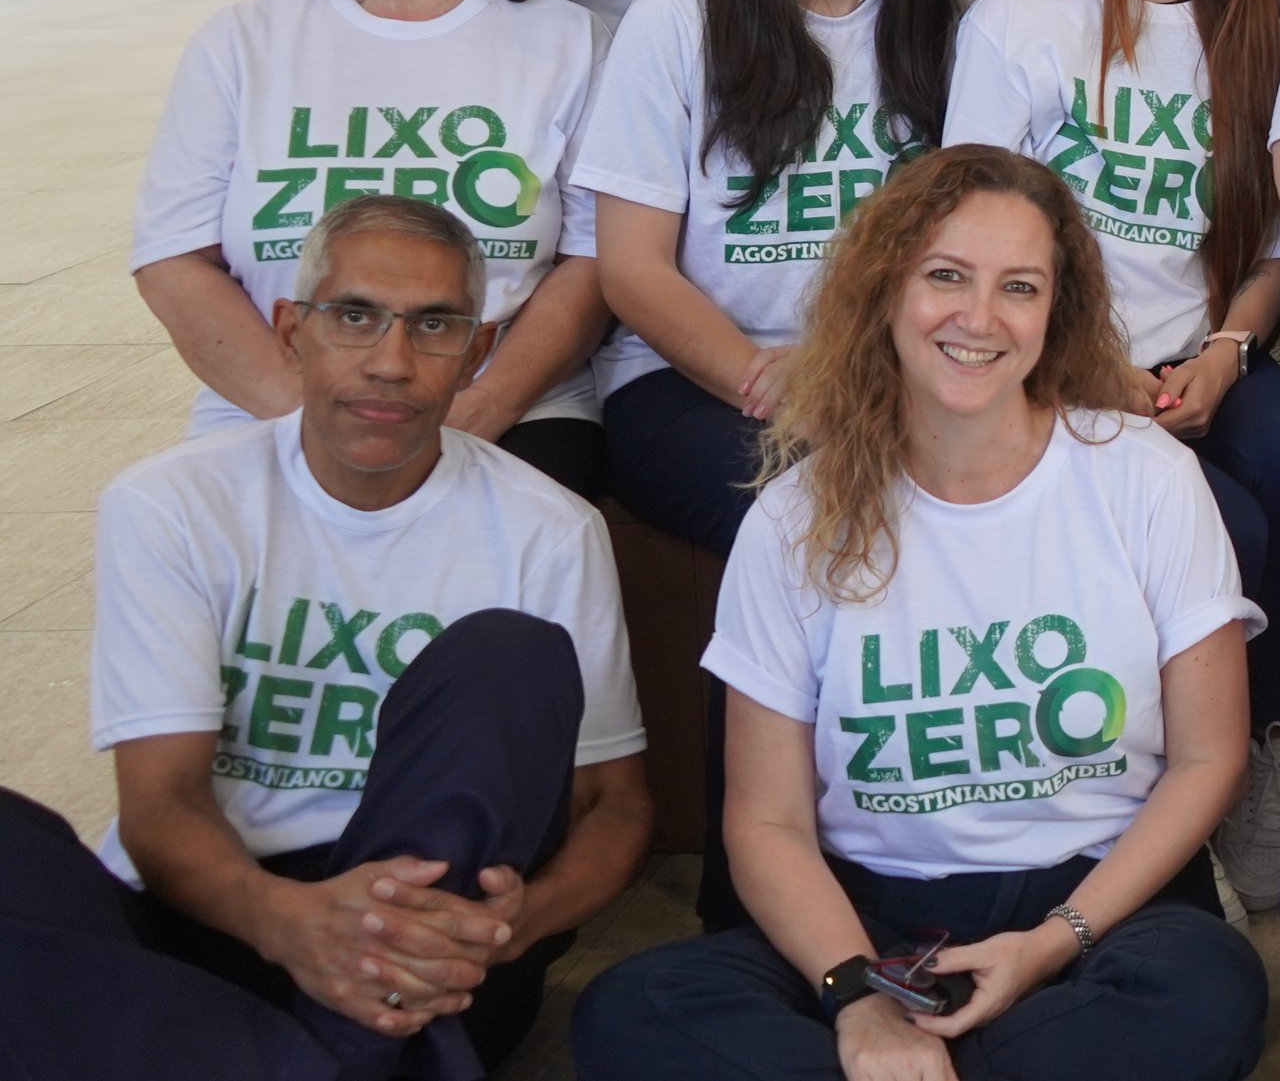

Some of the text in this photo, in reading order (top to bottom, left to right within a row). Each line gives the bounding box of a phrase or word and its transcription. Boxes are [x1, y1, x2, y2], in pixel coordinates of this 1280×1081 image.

[288, 105, 507, 158] LIXO
[861, 614, 1087, 704] LIXO
[839, 667, 1128, 783] ZERO
[861, 762, 1122, 812] AGOSTINIANO MENDEL
